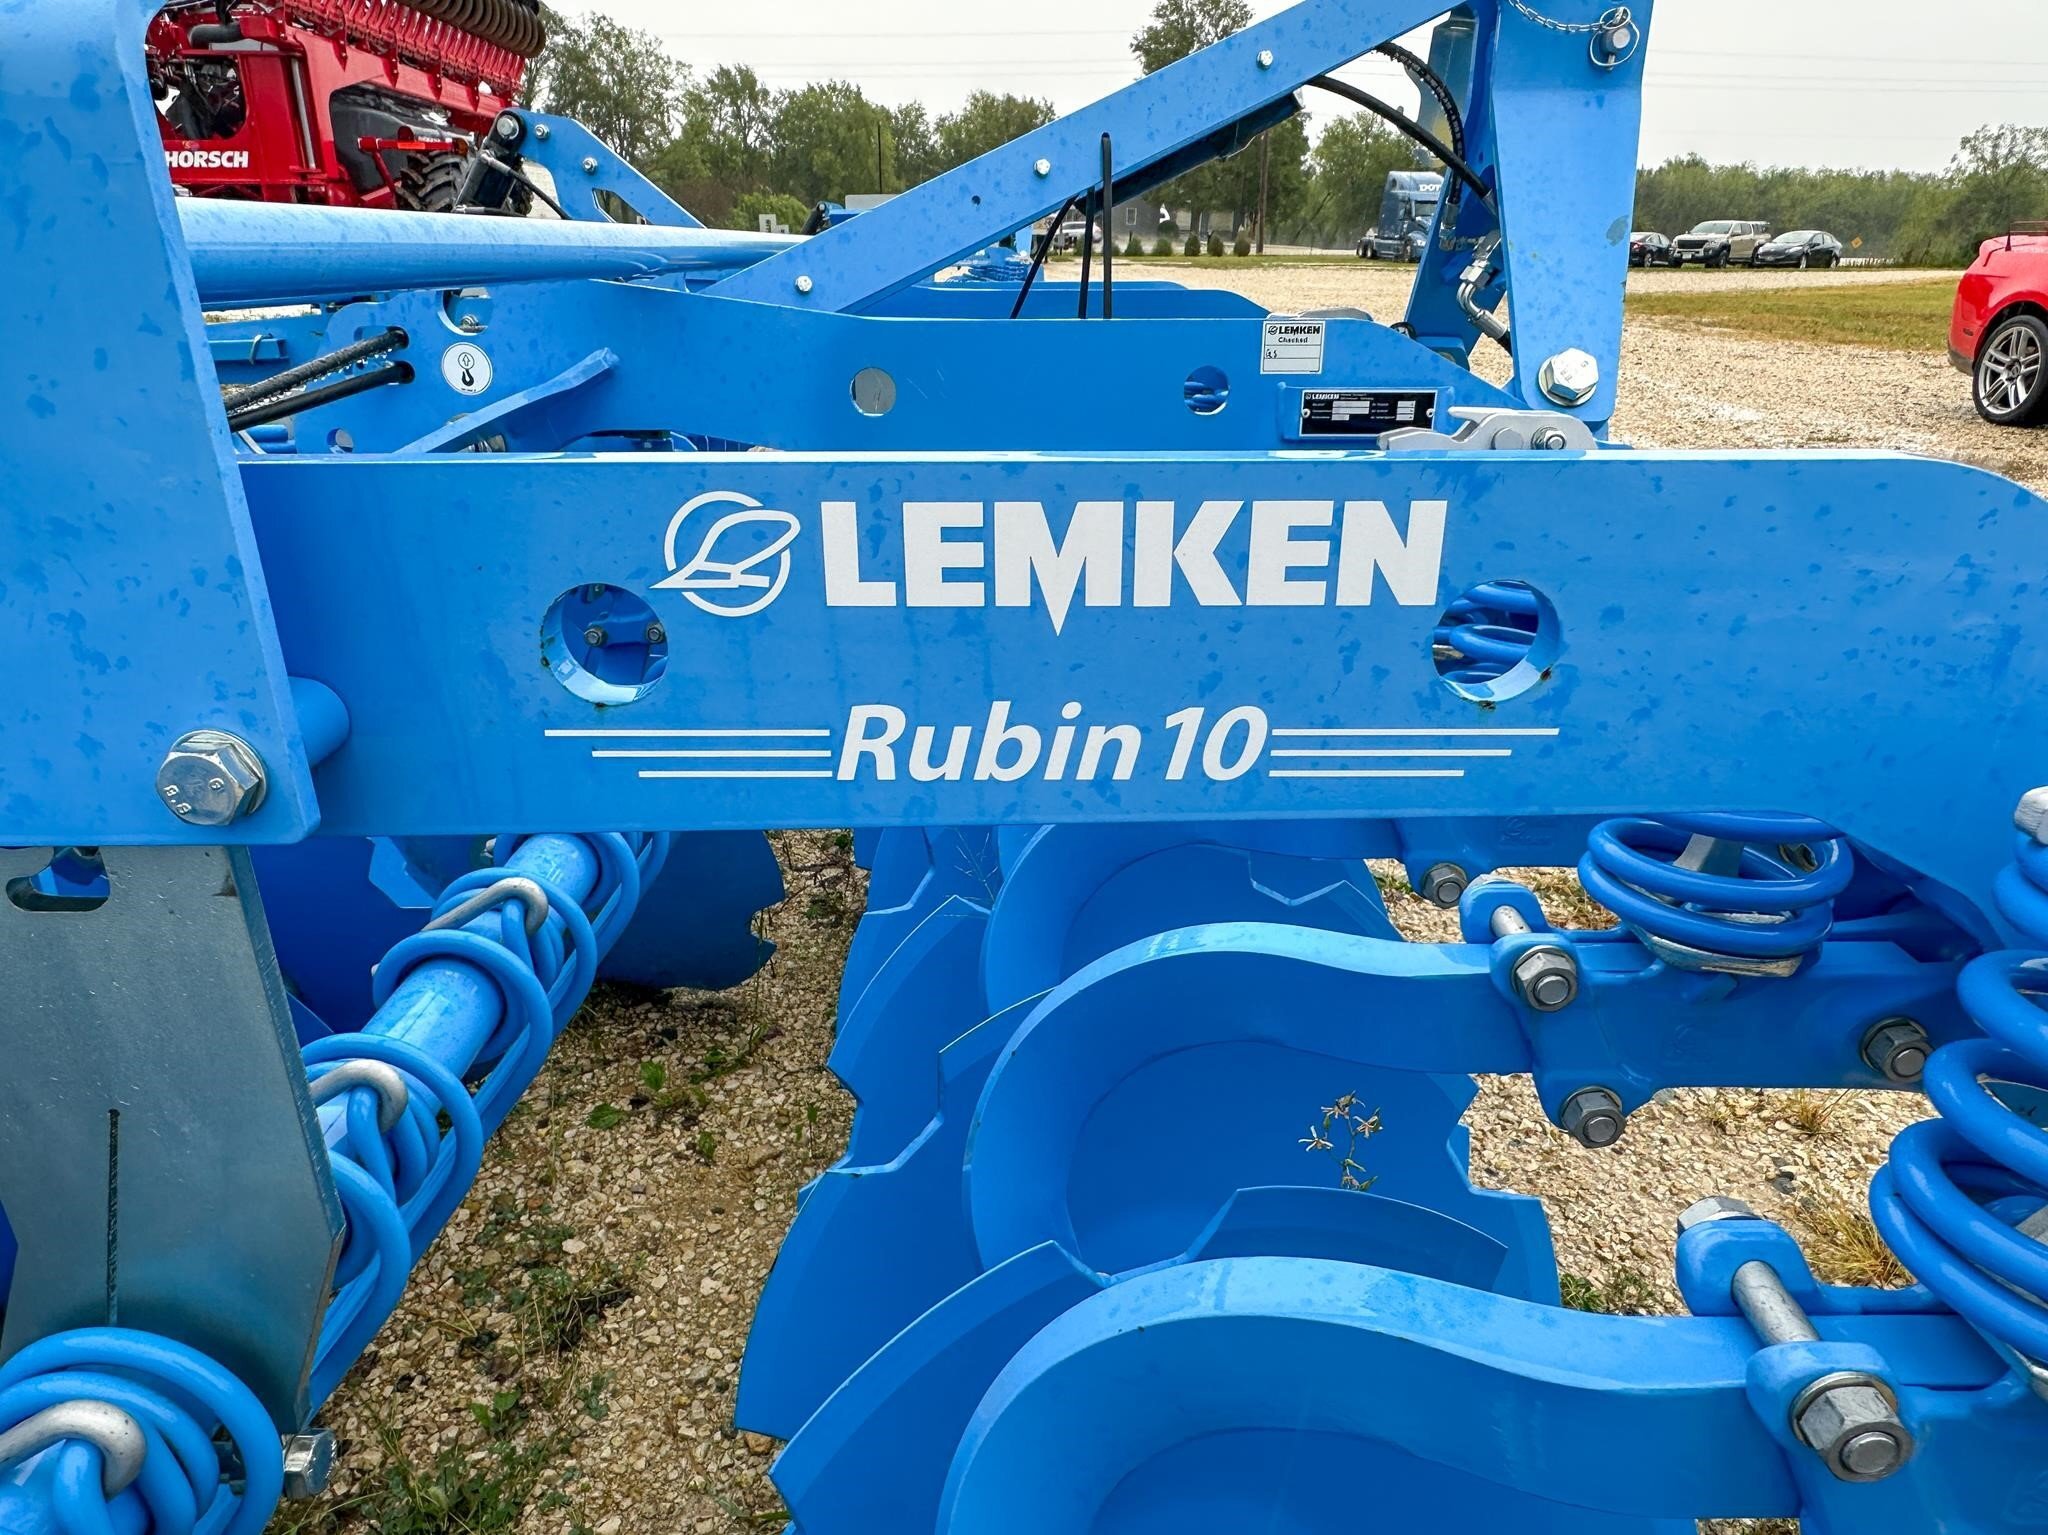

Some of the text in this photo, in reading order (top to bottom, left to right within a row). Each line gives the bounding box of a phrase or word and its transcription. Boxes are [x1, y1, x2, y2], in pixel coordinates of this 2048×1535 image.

[164, 150, 249, 169] HORSCH
[1278, 326, 1321, 335] LEMKEN
[820, 500, 1448, 636] LEMKEN
[837, 700, 1268, 782] Rubin 10
